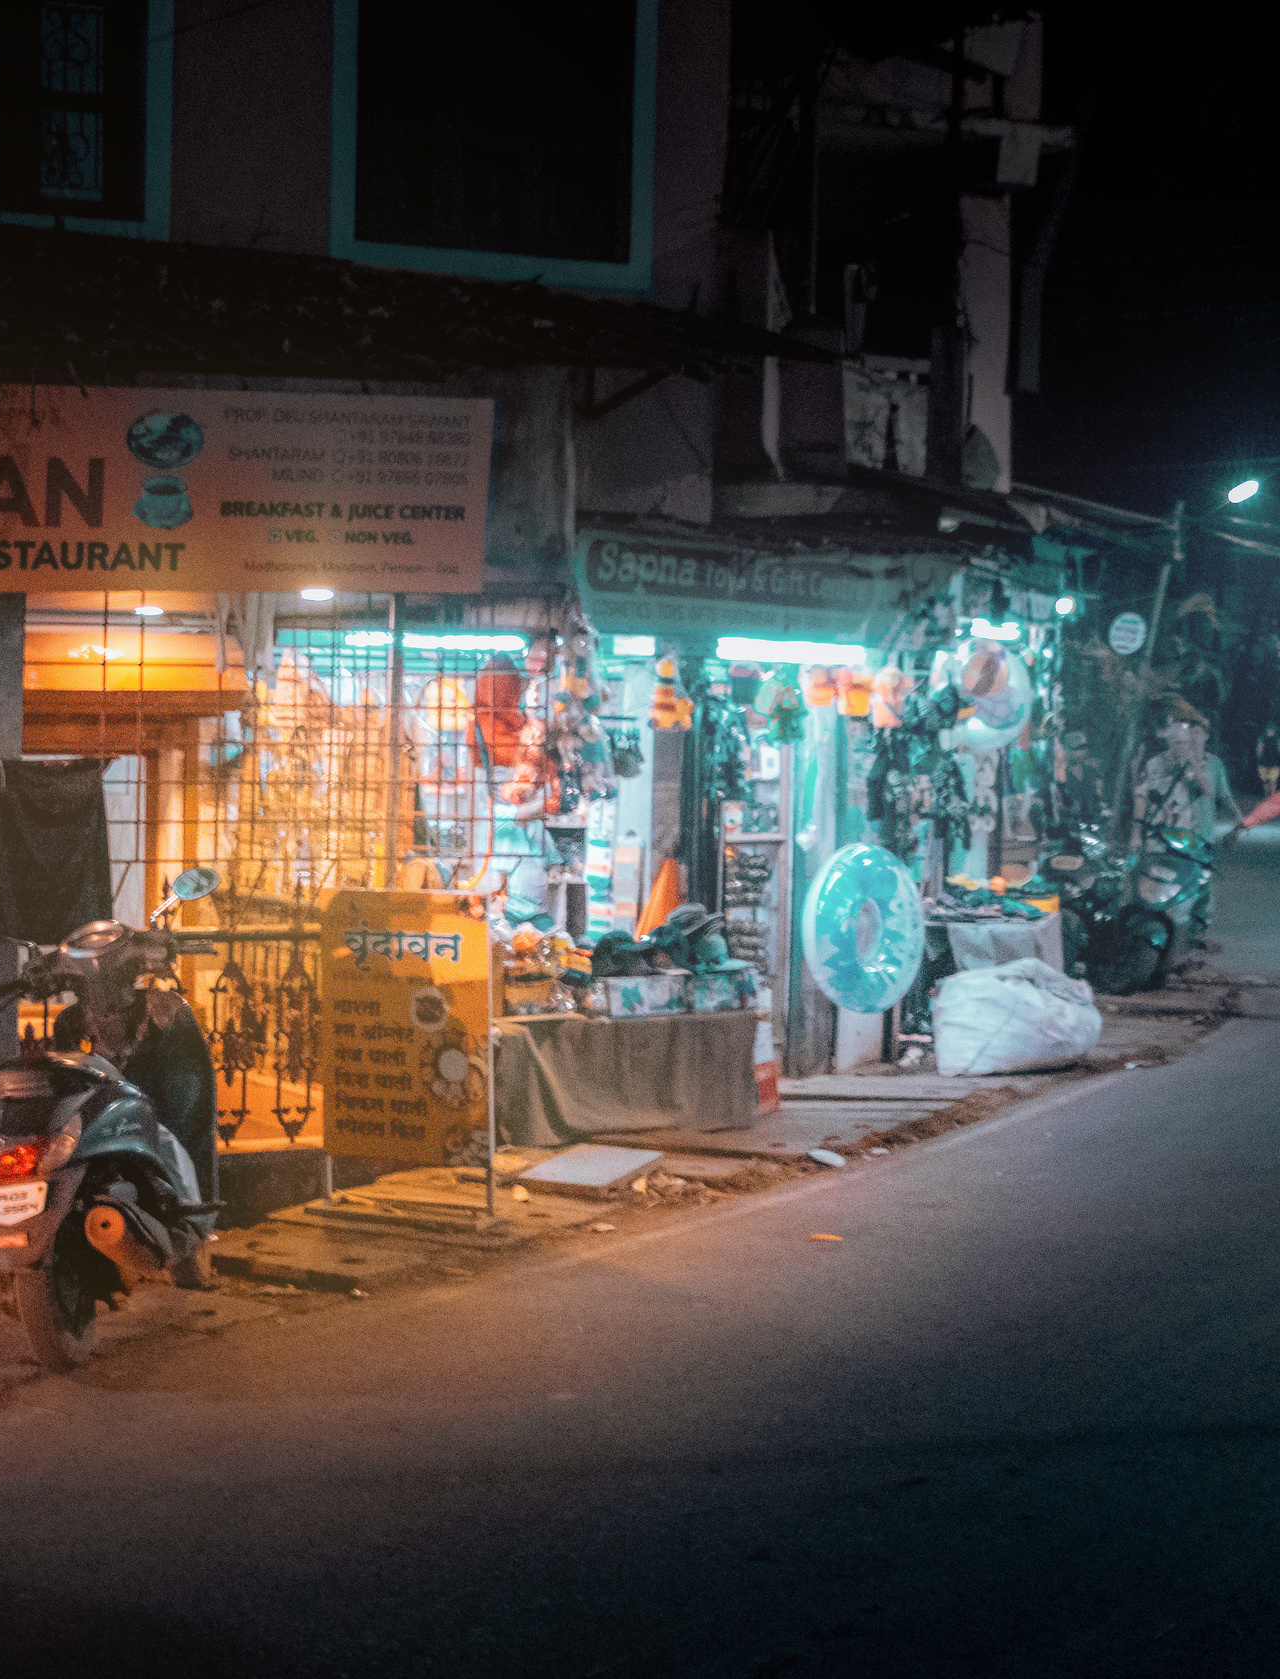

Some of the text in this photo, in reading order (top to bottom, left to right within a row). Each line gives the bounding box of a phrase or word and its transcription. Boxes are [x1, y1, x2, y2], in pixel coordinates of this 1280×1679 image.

[220, 501, 467, 522] BREAKFAST & JUICE CENTER
[345, 531, 378, 545] NON
[598, 543, 697, 593] Sapna
[344, 920, 463, 971] वृंदावन
